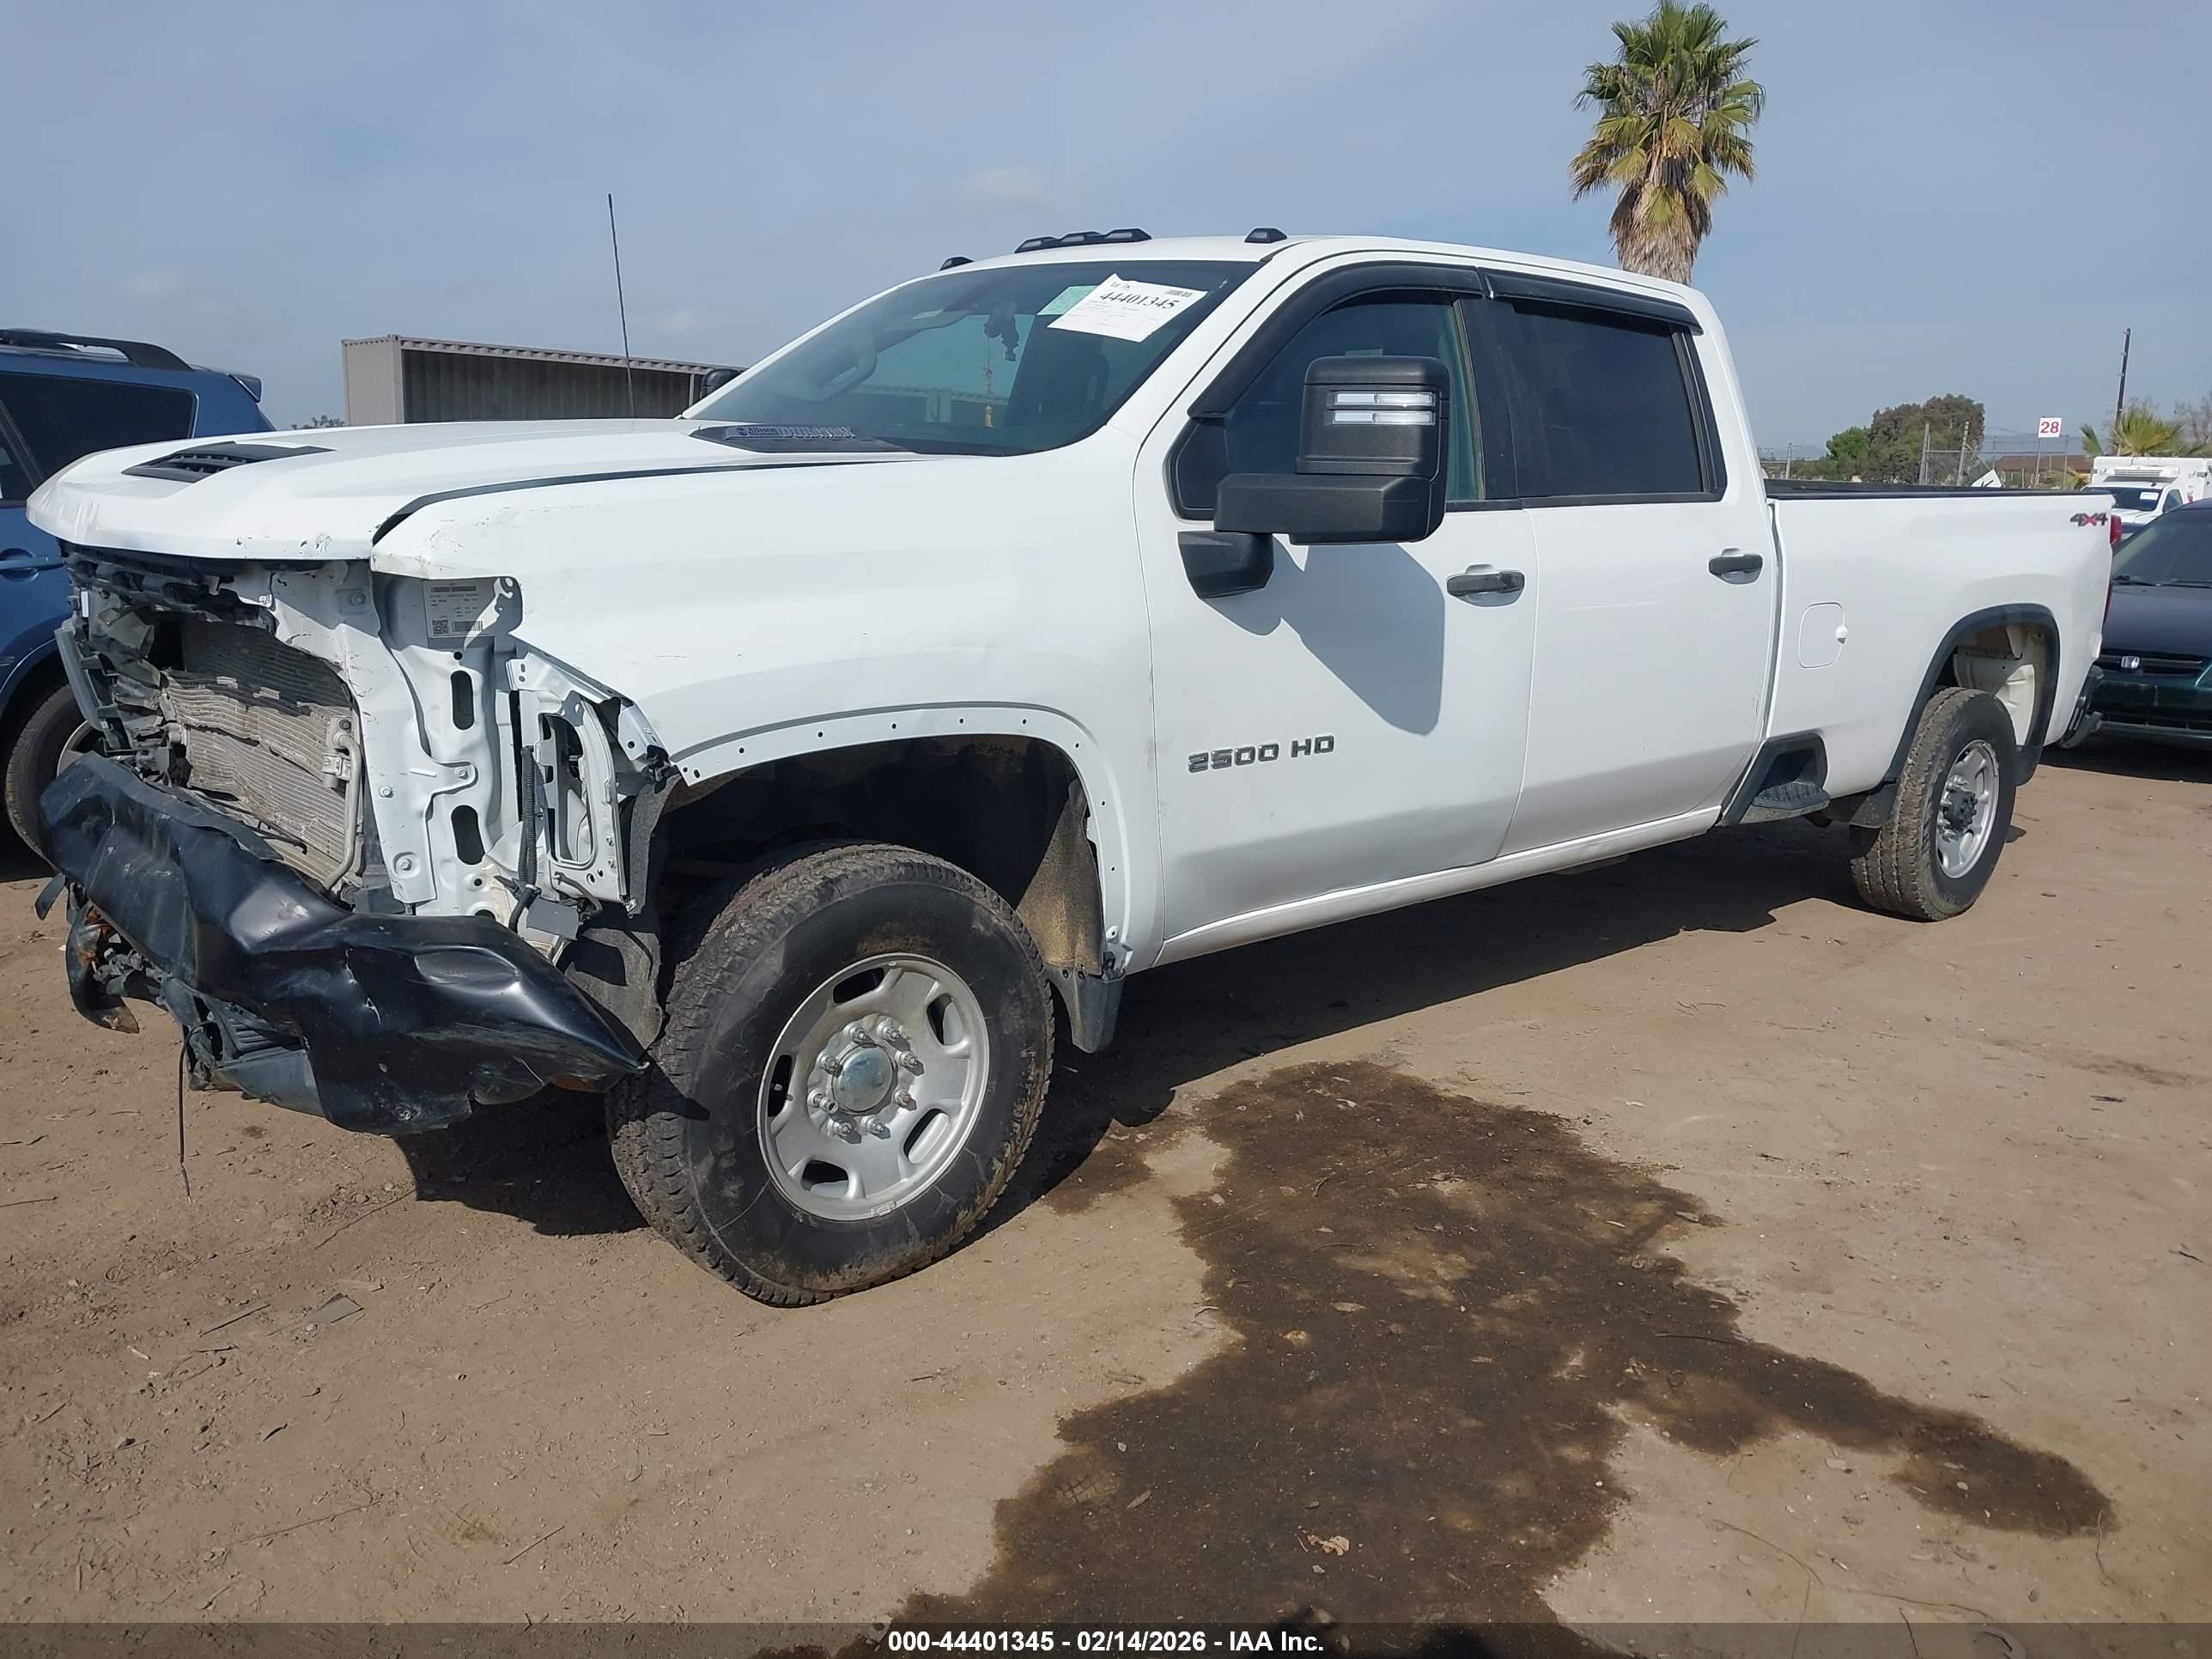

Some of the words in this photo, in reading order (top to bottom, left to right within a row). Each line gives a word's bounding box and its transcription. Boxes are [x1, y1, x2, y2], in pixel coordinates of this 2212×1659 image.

[1099, 291, 1180, 310] 44401345
[2040, 421, 2060, 434] 28
[1188, 743, 1279, 774] 2500
[1291, 735, 1334, 758] HD
